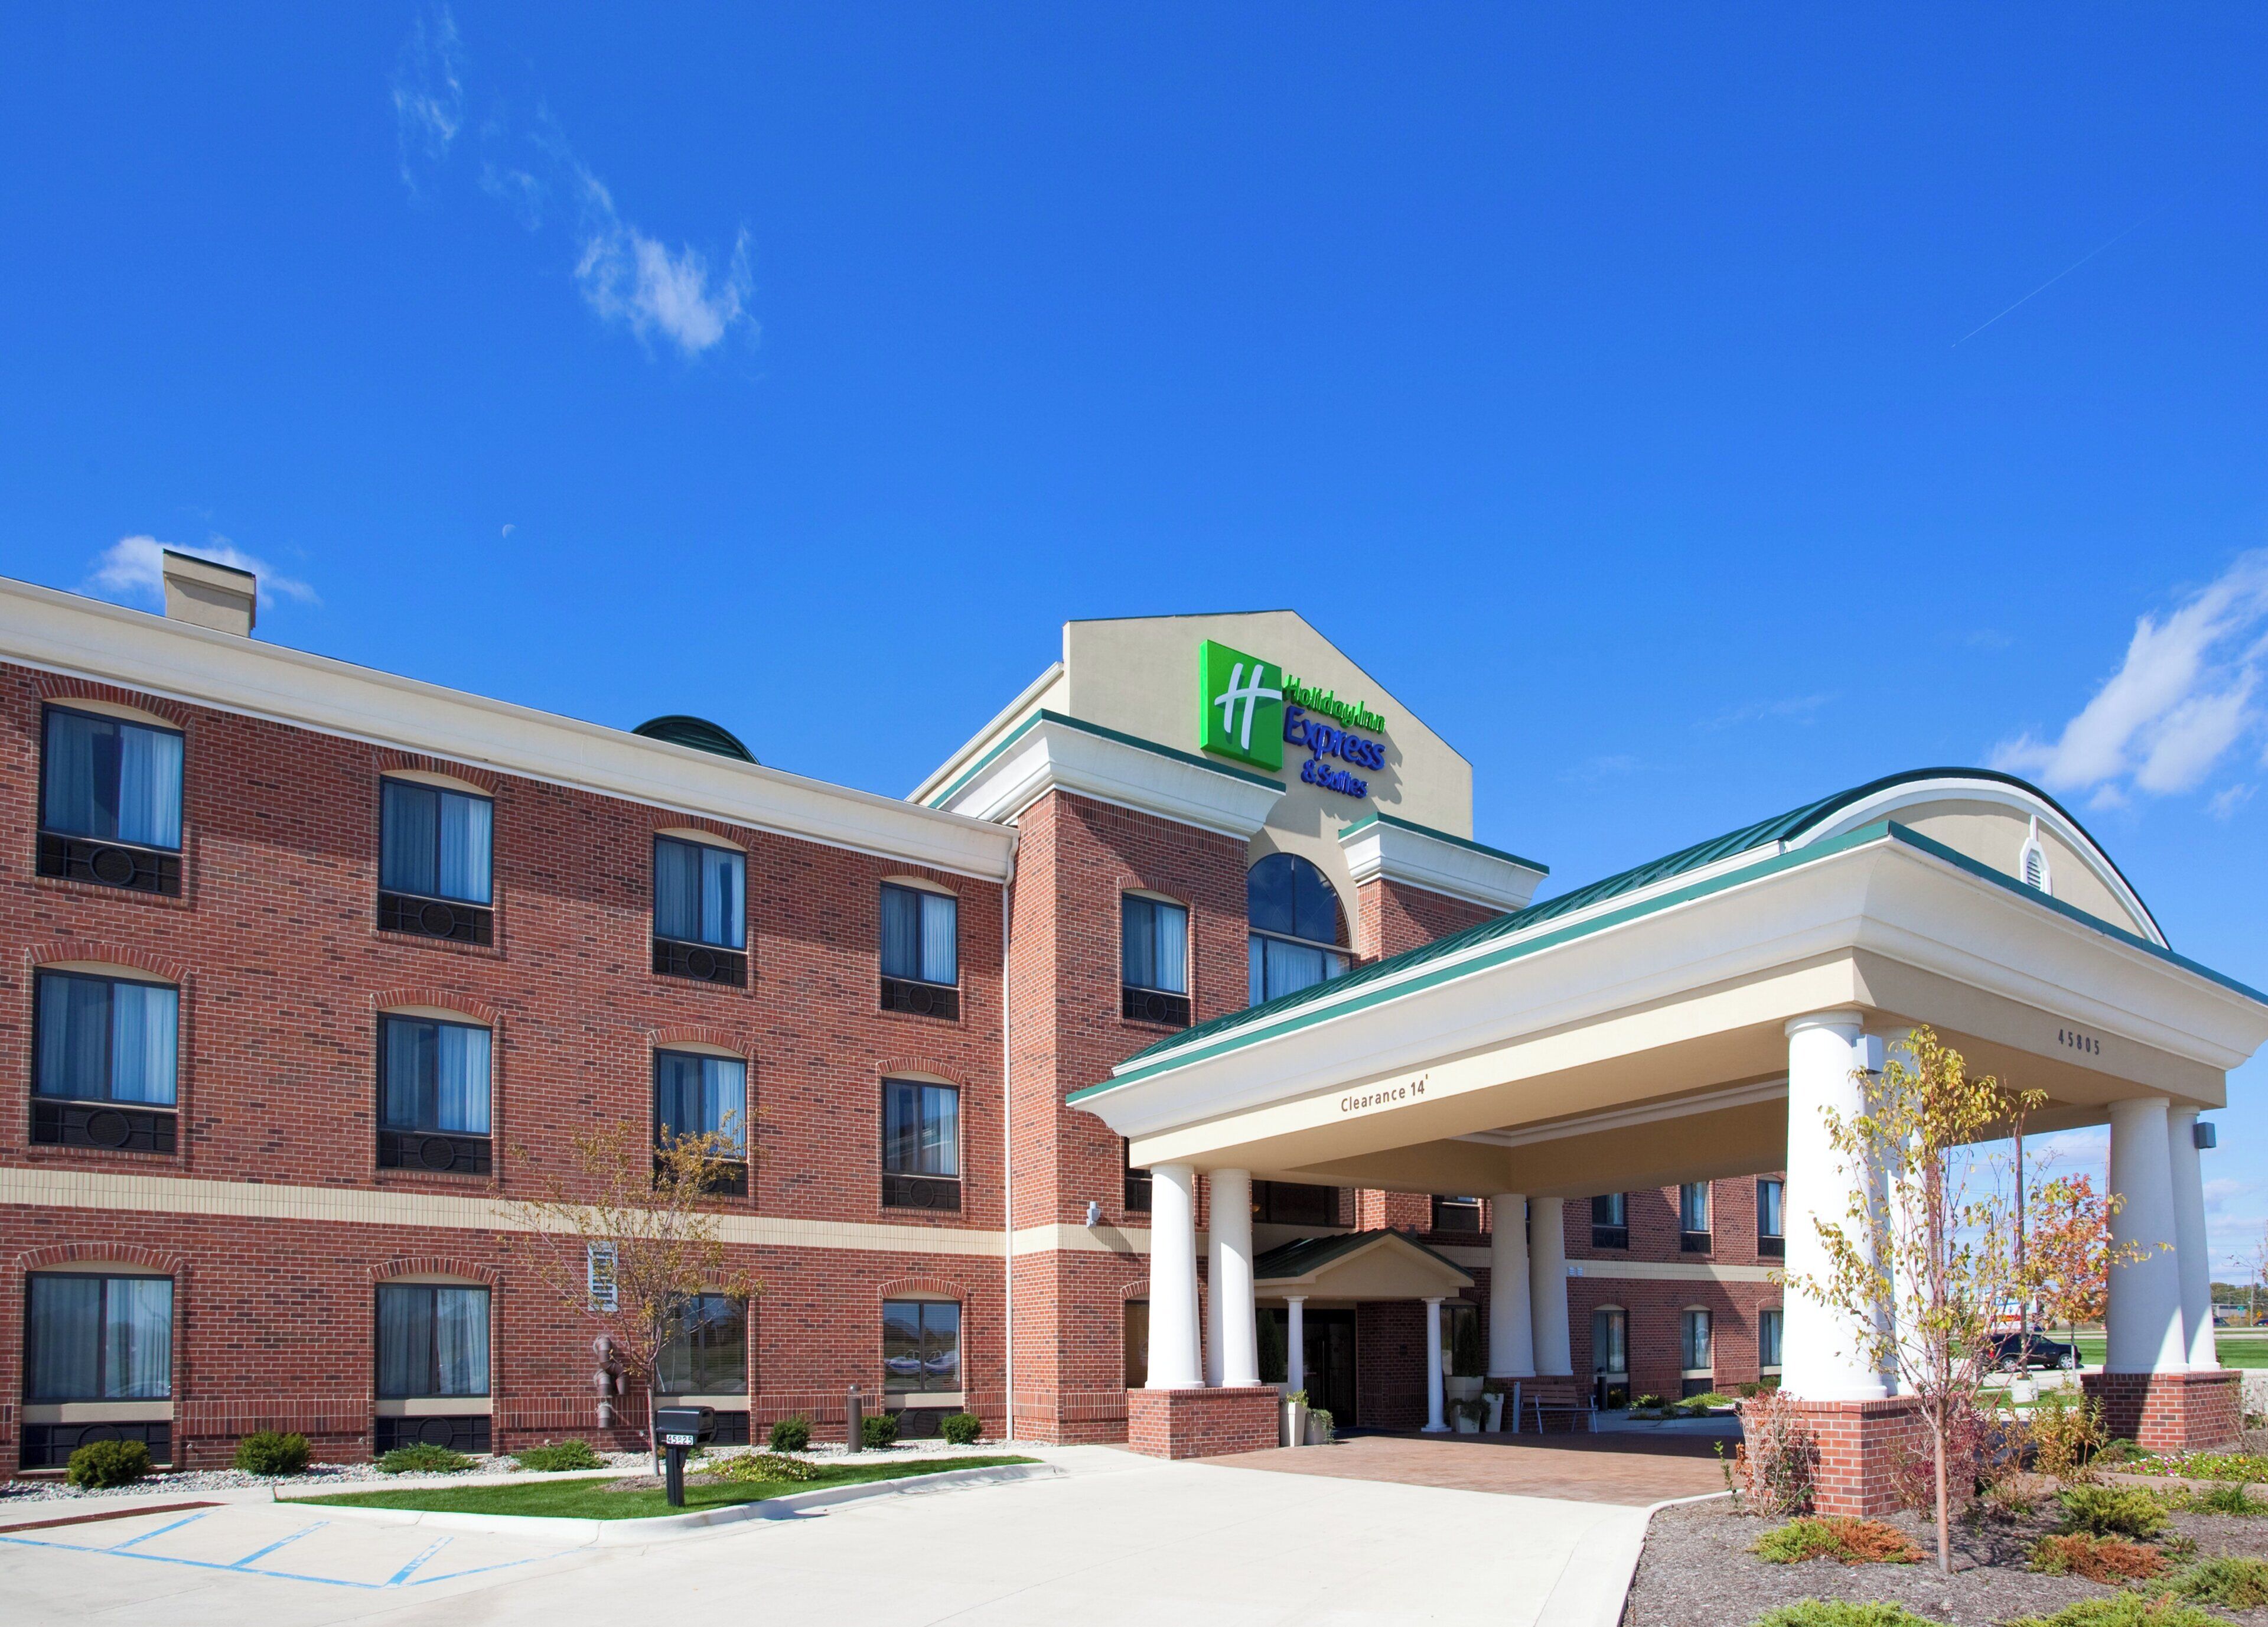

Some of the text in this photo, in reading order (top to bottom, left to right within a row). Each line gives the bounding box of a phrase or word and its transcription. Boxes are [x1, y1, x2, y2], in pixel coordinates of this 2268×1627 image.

[1282, 675, 1386, 734] Holiday Inn
[1283, 705, 1386, 771] Express
[1301, 759, 1368, 799] & Suites
[2058, 1029, 2100, 1055] 45805
[1341, 1088, 1406, 1112] Clearance
